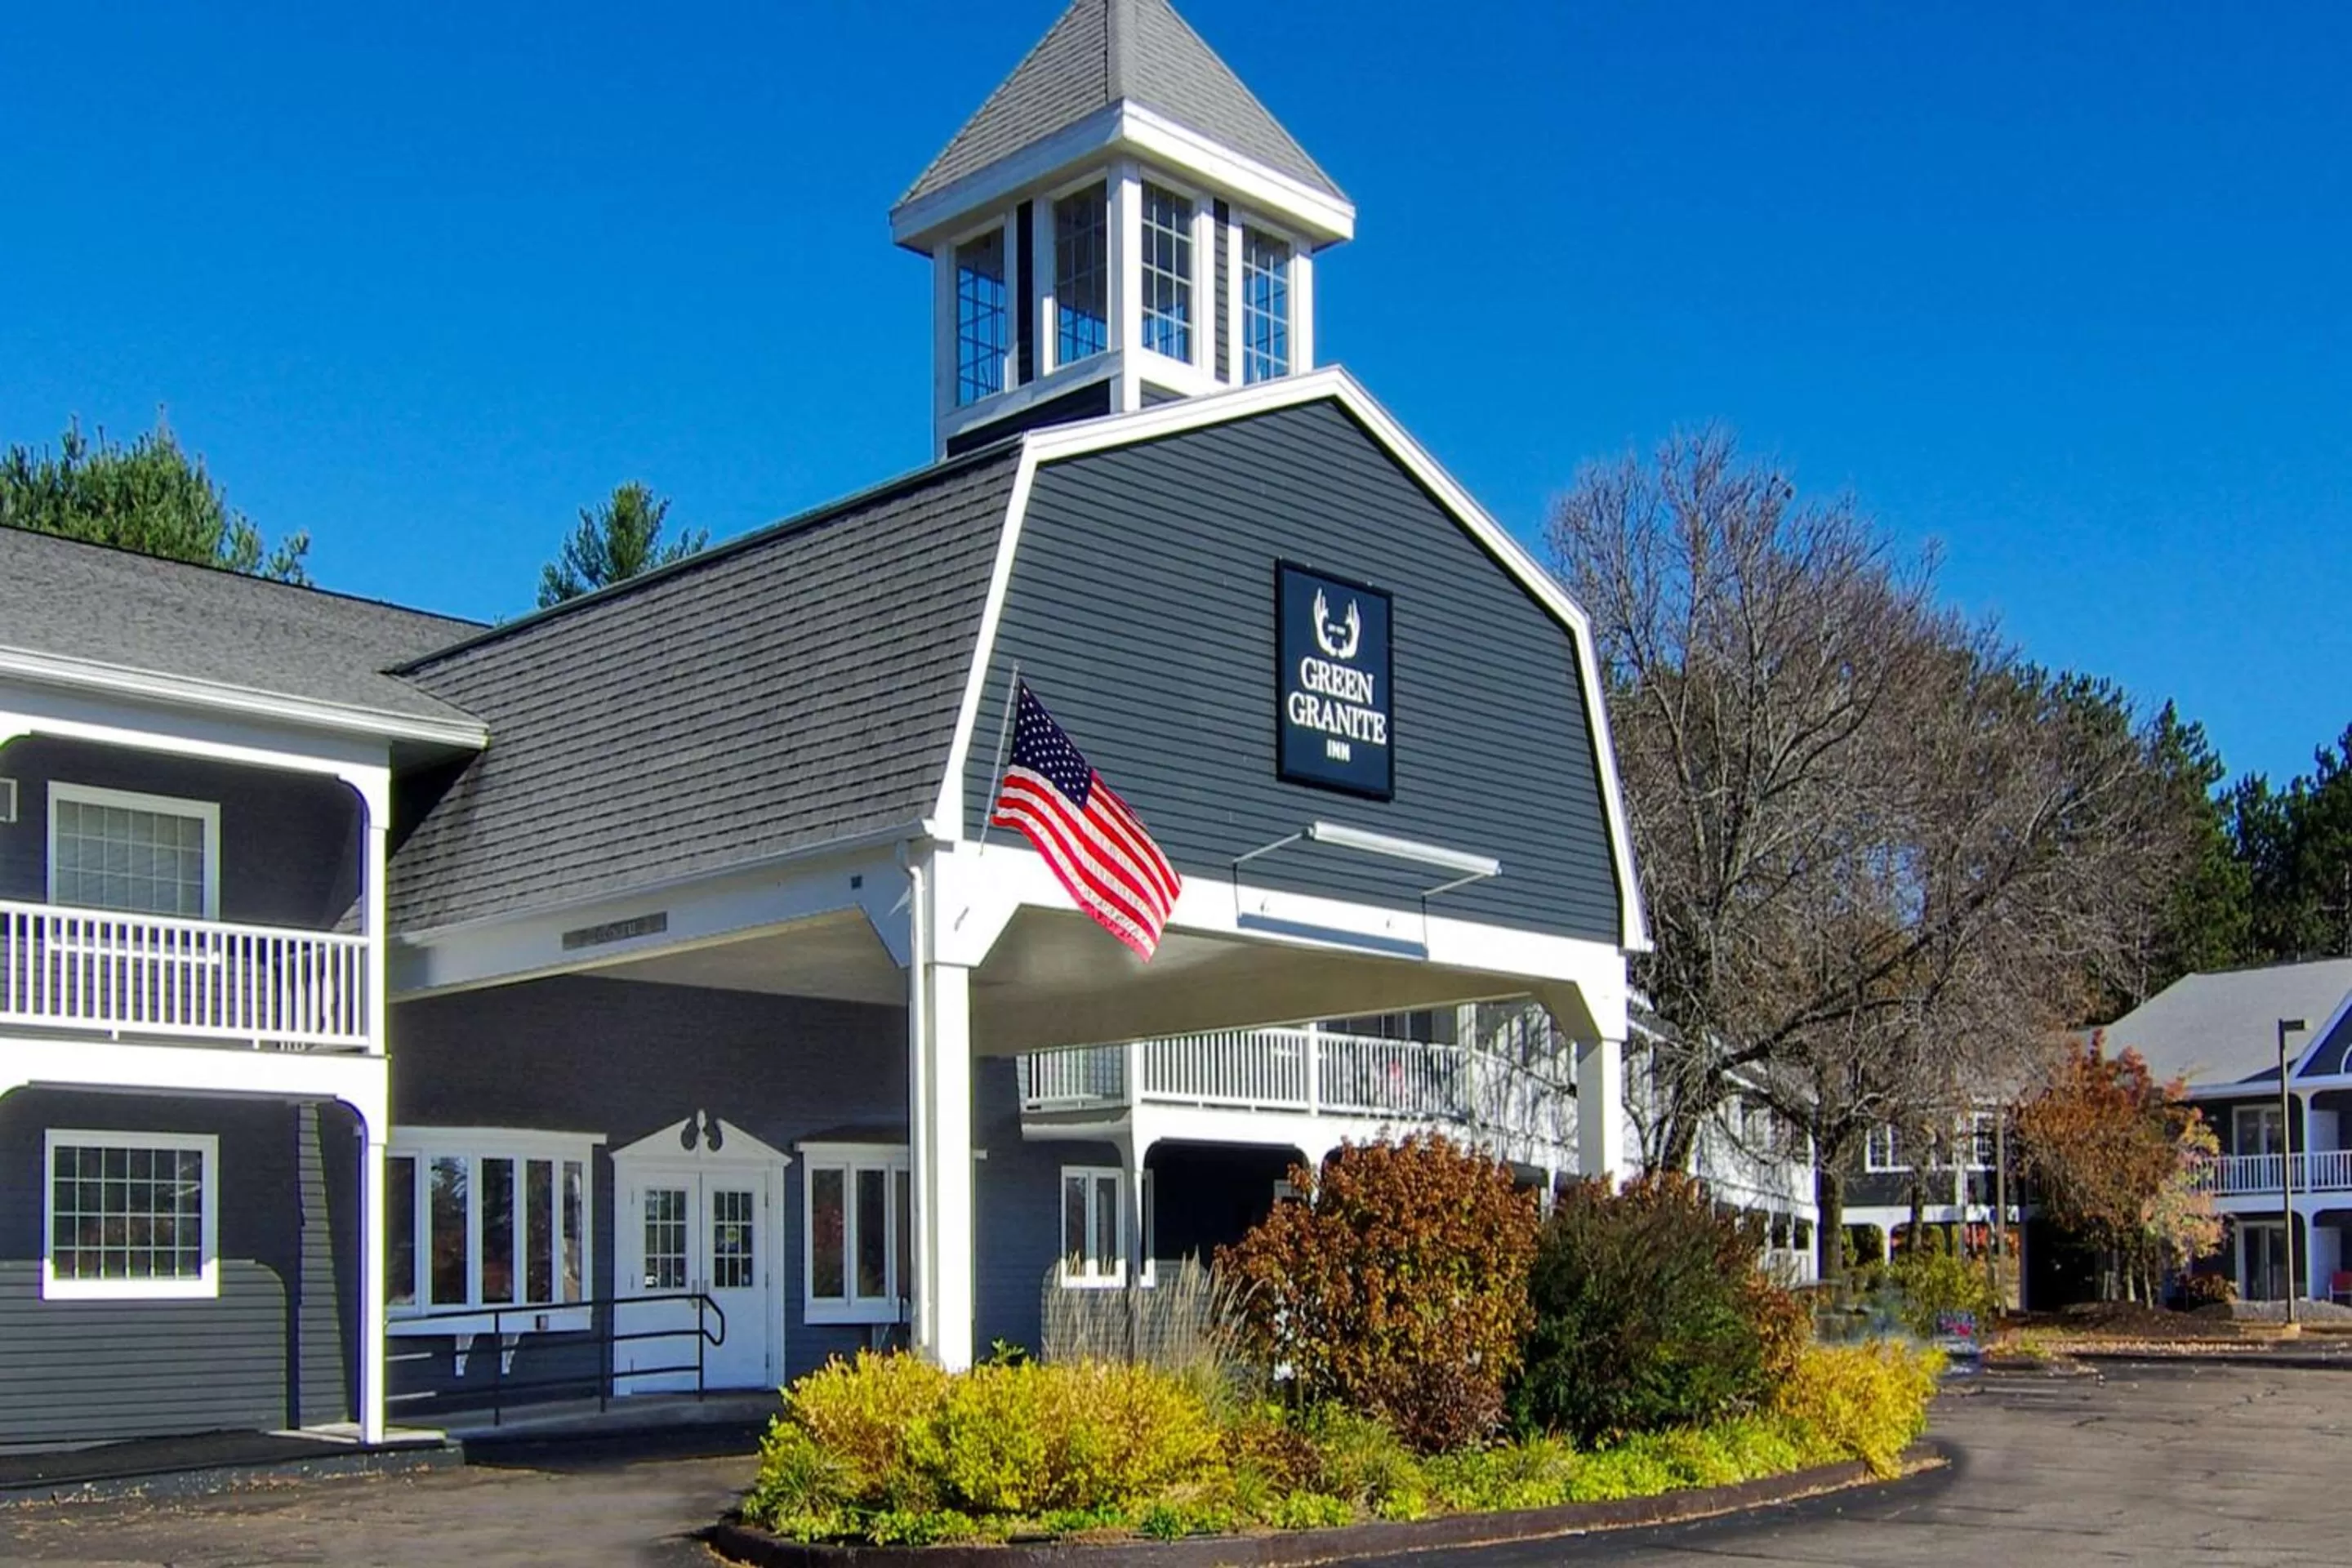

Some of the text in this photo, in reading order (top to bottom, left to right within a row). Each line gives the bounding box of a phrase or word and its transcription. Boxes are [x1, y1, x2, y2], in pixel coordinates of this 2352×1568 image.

[1300, 657, 1374, 705] GREEN
[1288, 691, 1386, 745] GRANITE
[1326, 738, 1351, 762] INN
